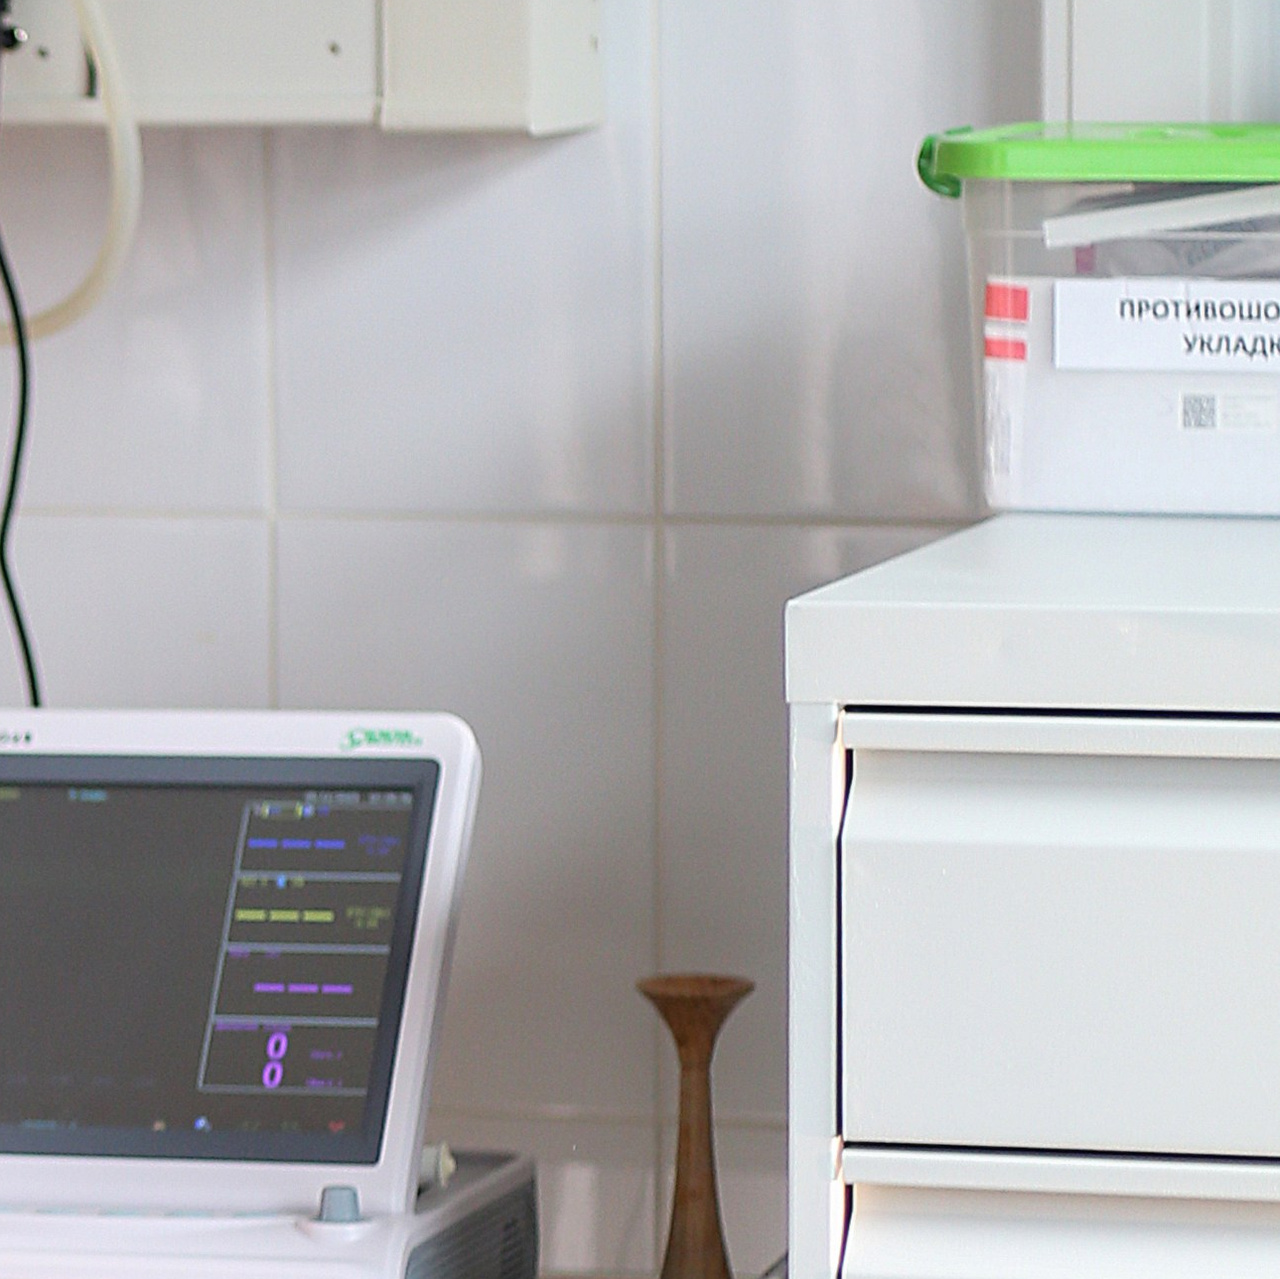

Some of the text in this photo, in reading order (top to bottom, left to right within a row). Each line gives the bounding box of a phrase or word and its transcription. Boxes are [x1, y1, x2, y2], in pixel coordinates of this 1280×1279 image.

[1119, 298, 1280, 321] ПРОТИВОШО
[266, 1031, 289, 1060] 0
[262, 1060, 284, 1089] 0
